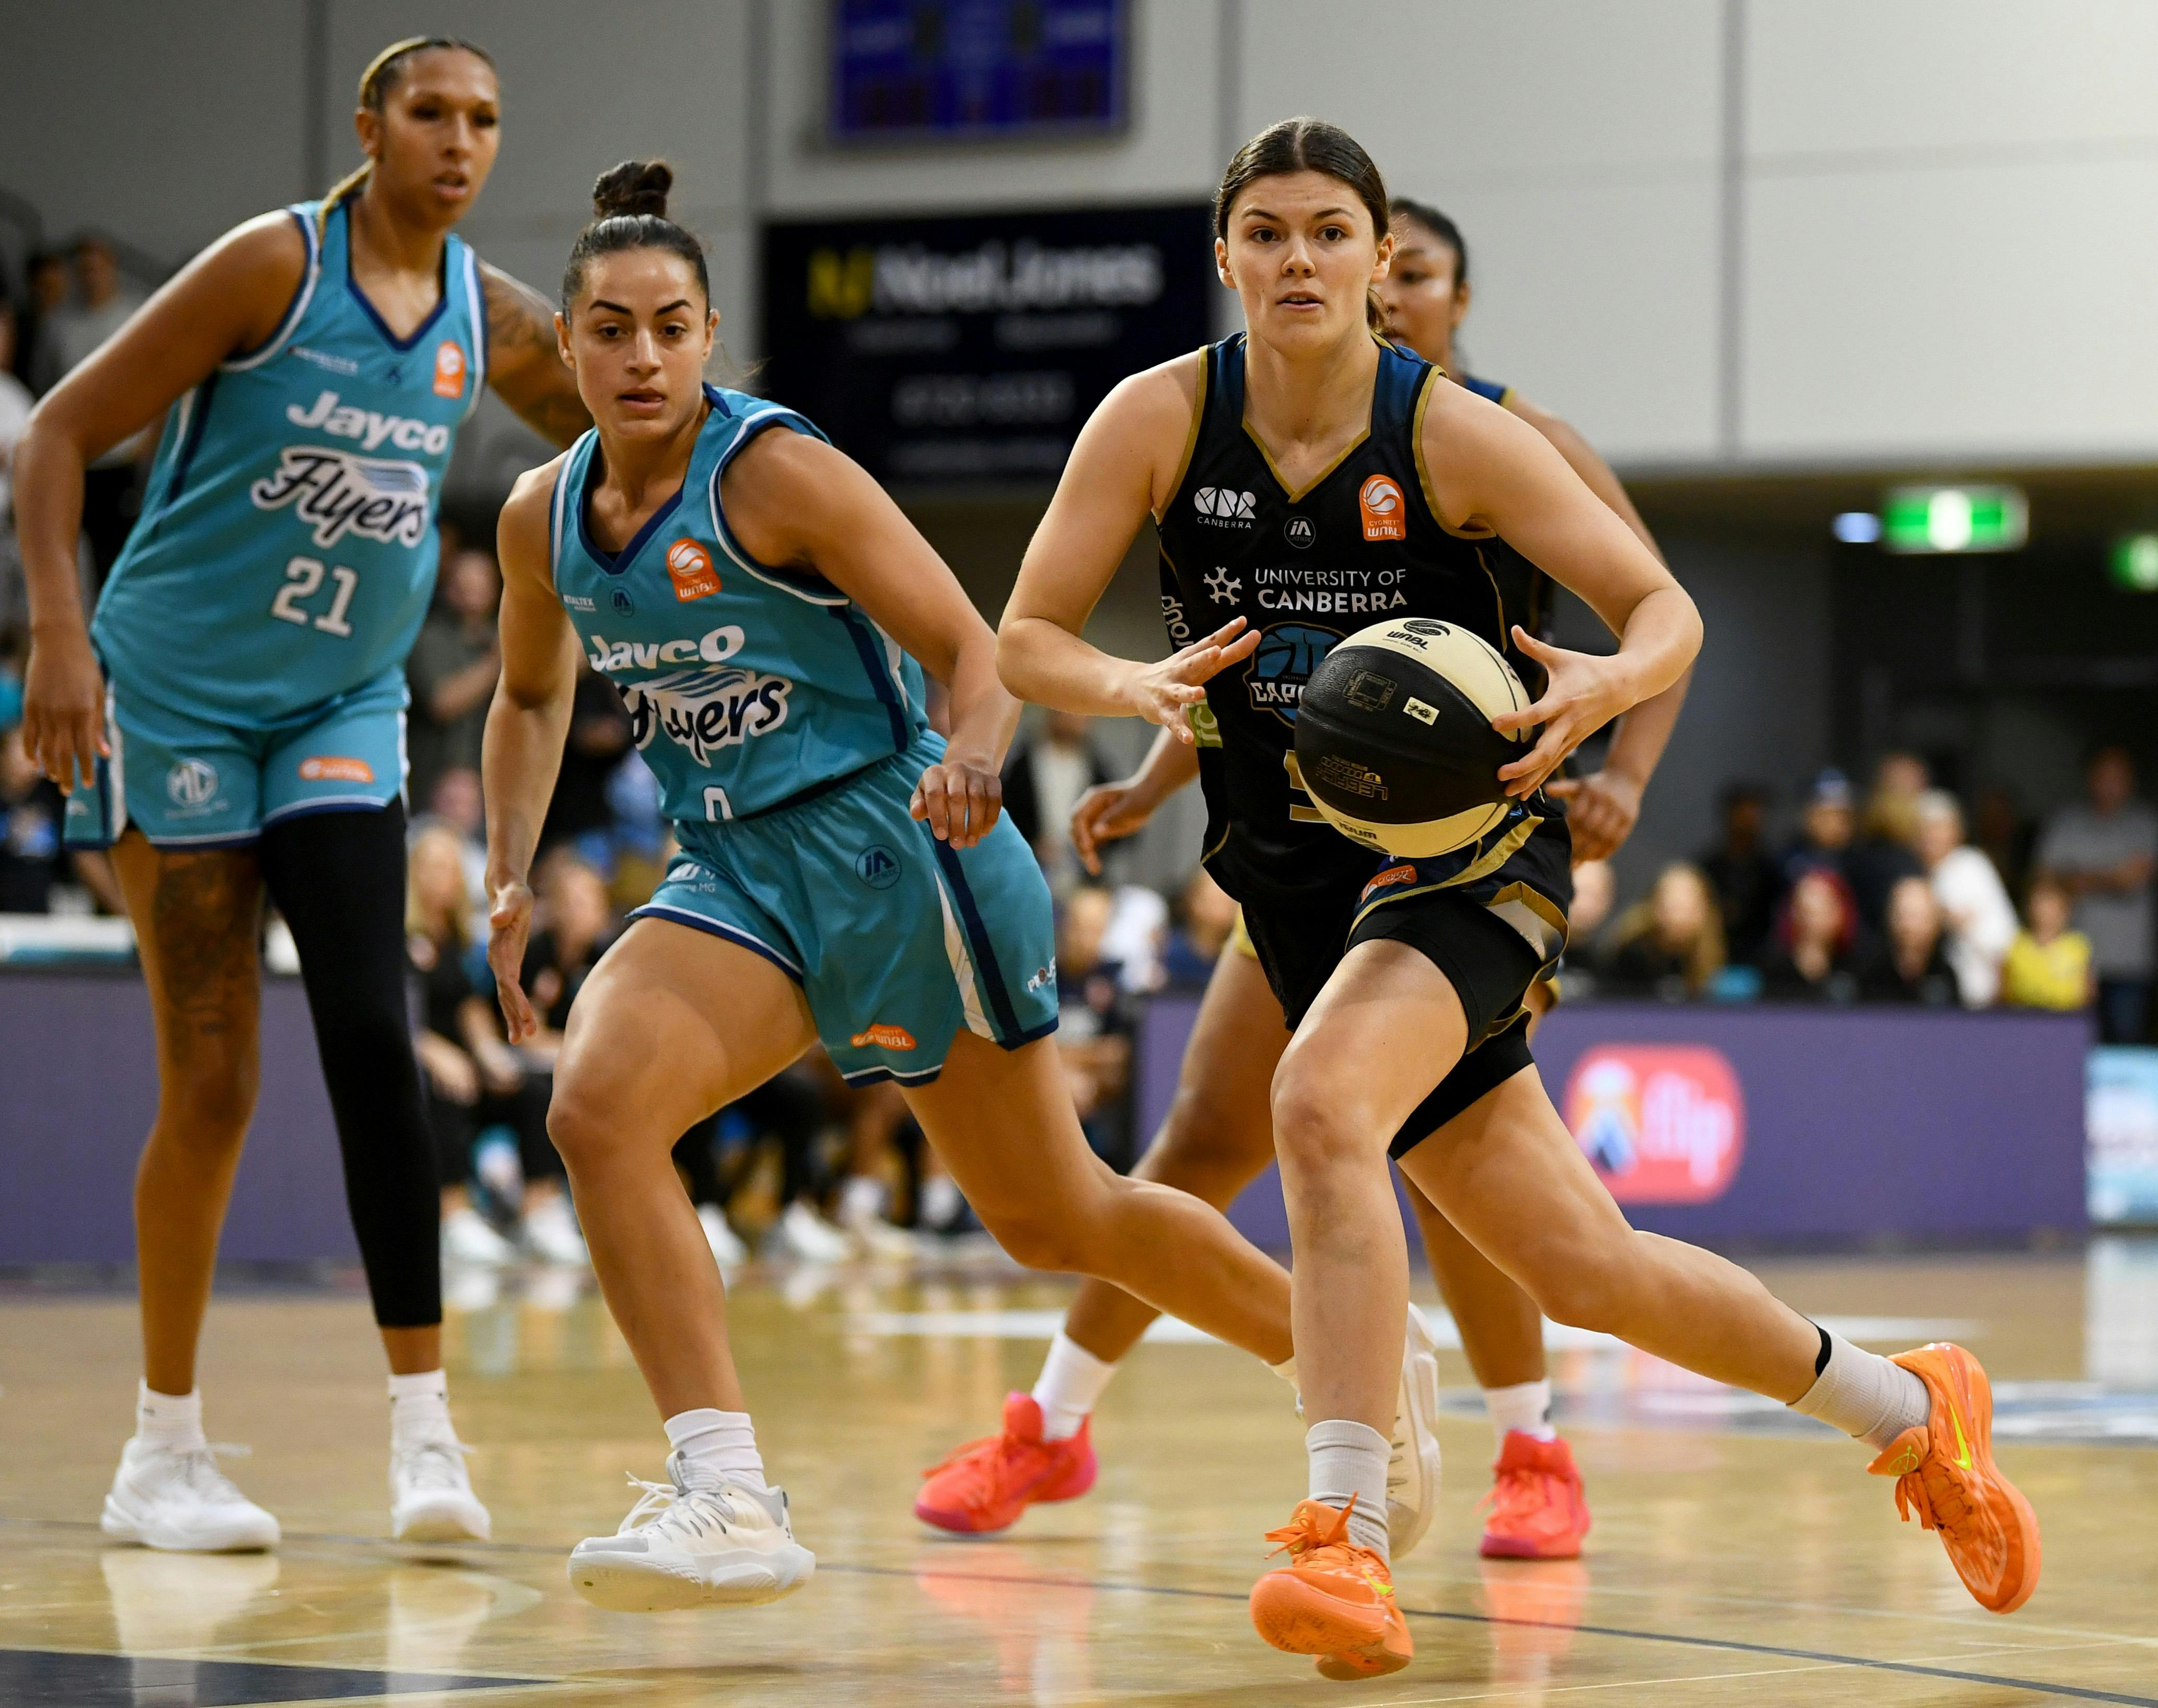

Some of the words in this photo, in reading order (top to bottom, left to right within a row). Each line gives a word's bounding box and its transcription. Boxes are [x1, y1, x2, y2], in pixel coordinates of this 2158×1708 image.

[286, 390, 449, 455] Jayco
[251, 446, 428, 548] Flyers
[1197, 516, 1251, 529] CANBERRA
[1368, 526, 1401, 536] WNBL
[1255, 568, 1371, 587] UNIVERSITY
[1378, 569, 1406, 585] OF
[272, 556, 358, 637] 21
[1258, 589, 1408, 613] CANBERRA
[1387, 631, 1428, 650] WNBL
